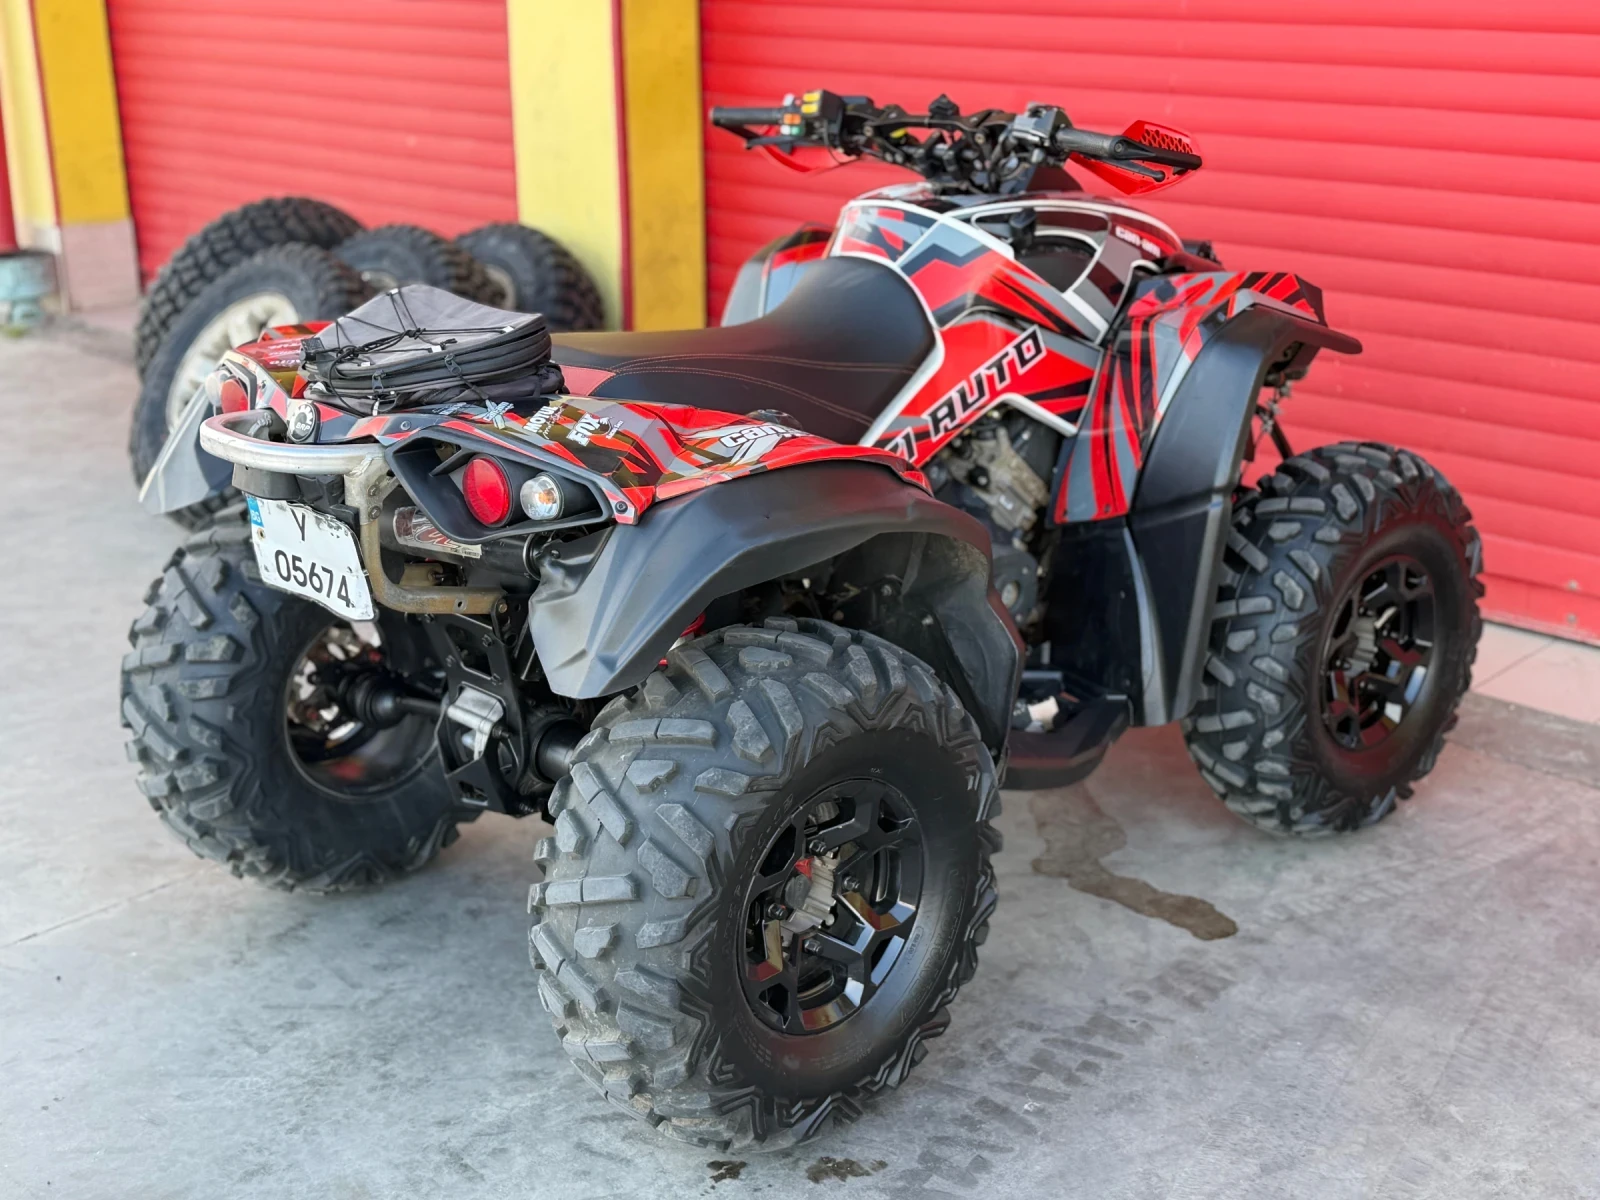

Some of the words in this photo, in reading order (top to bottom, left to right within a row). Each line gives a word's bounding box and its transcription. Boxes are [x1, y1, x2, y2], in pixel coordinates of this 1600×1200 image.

[1115, 225, 1161, 259] can-am
[923, 326, 1046, 440] AUTO
[295, 422, 311, 432] BRP
[522, 404, 559, 433] MOTUL
[566, 411, 600, 447] FOX
[250, 509, 261, 522] BG
[289, 506, 306, 542] Y
[274, 549, 352, 608] 05674
